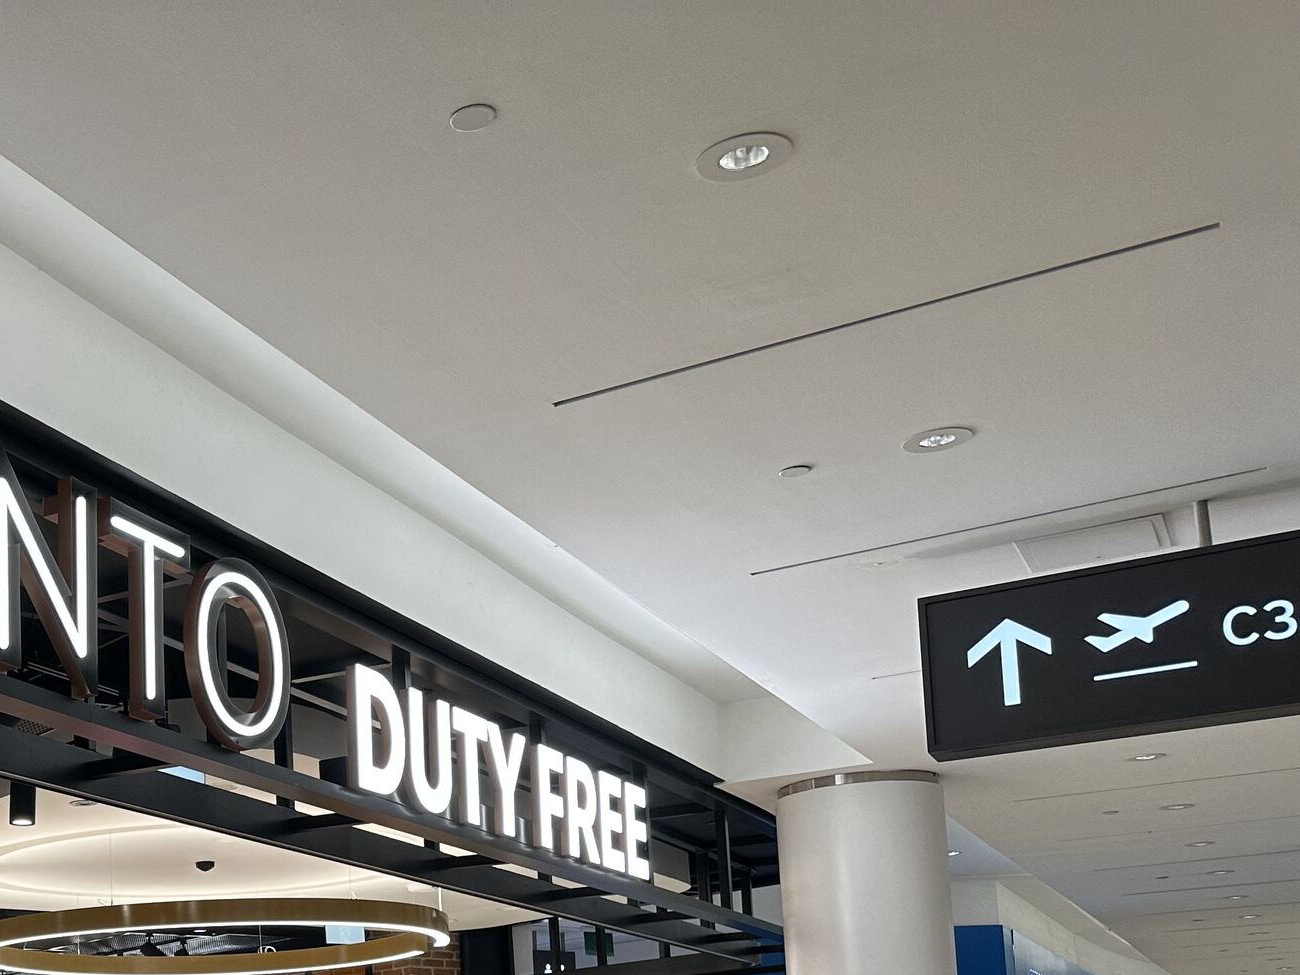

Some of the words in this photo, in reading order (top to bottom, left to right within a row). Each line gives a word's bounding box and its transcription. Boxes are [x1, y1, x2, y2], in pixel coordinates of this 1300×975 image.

[1222, 599, 1299, 646] C3
[348, 661, 526, 838] DUTY
[530, 742, 651, 881] FREE
